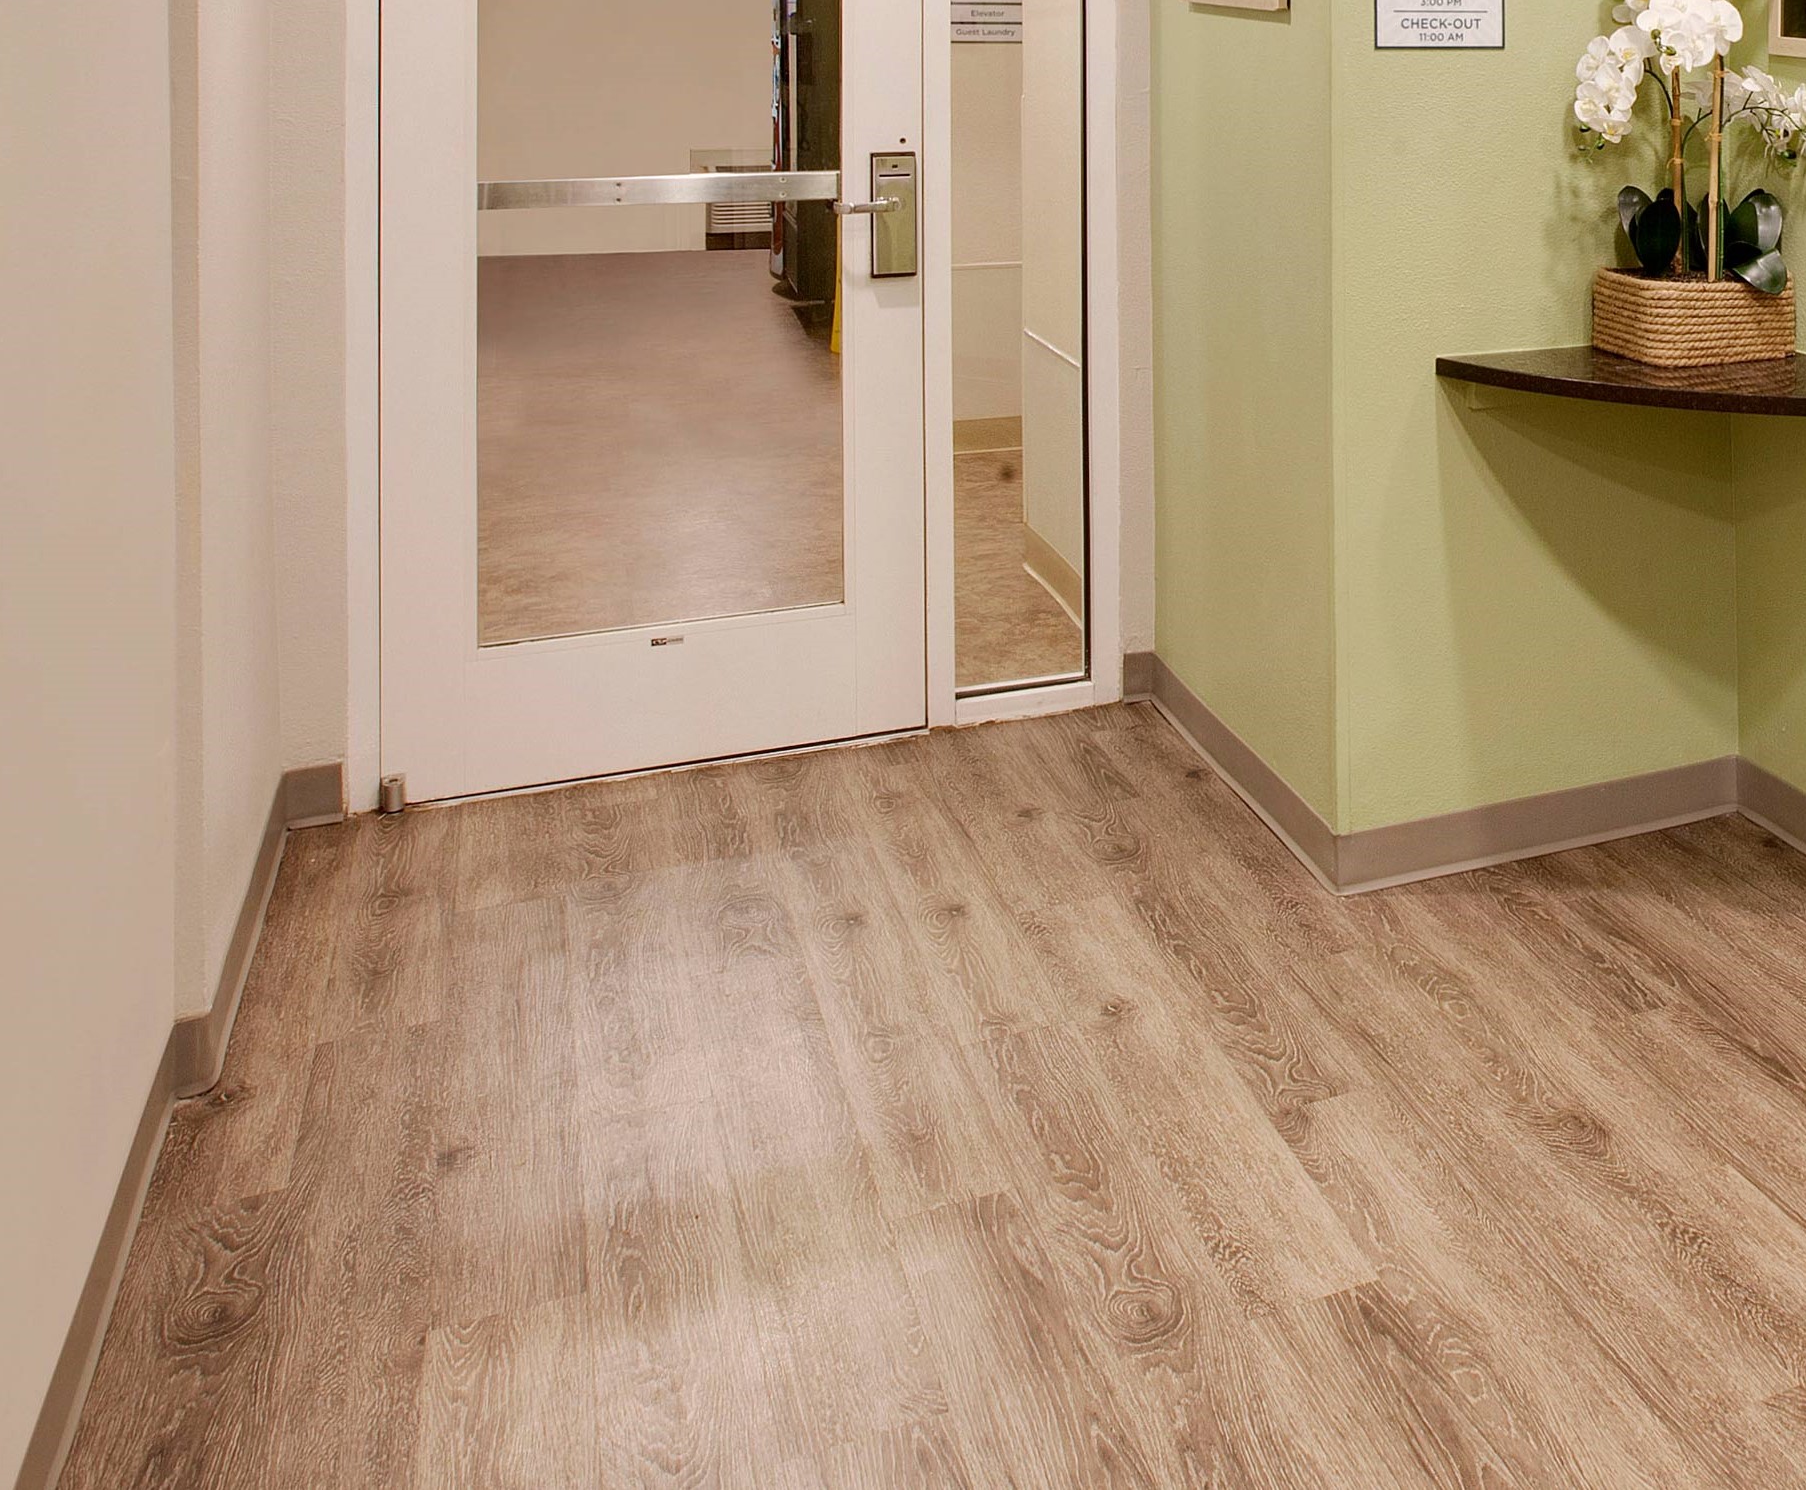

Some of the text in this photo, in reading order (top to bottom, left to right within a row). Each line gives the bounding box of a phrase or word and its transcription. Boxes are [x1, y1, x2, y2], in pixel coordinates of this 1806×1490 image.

[1400, 18, 1481, 30] CHECK-OUT
[982, 29, 1016, 37] Laundry
[1418, 33, 1464, 42] 11:00 AM
